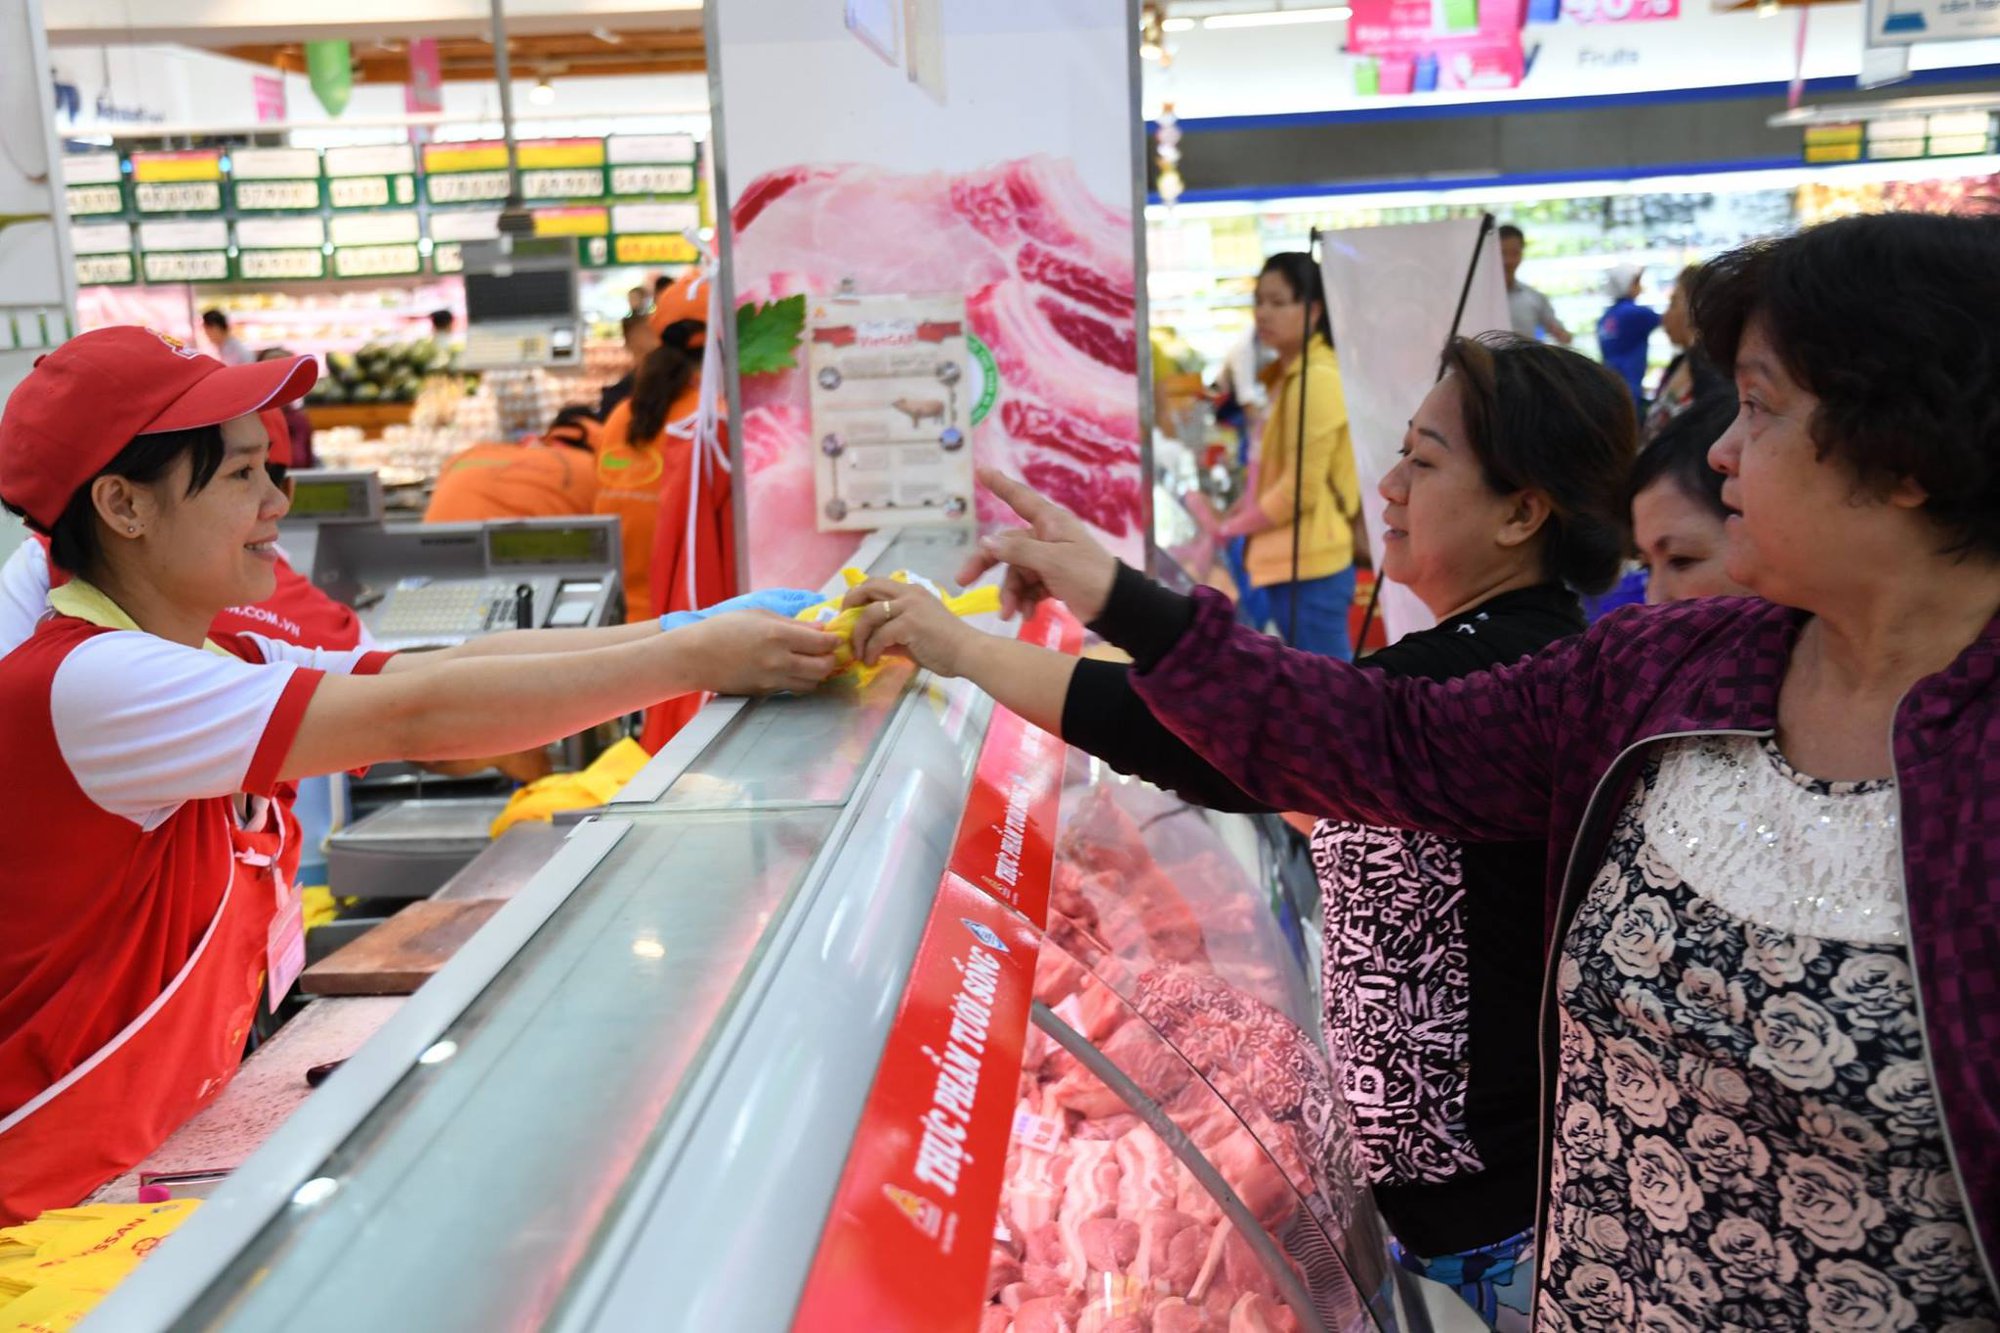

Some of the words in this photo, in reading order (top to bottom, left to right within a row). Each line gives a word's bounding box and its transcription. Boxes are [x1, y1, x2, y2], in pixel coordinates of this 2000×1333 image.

[951, 945, 1001, 1006] SỐNG
[949, 991, 992, 1055] TƯƠI
[914, 1107, 974, 1196] THỰC
